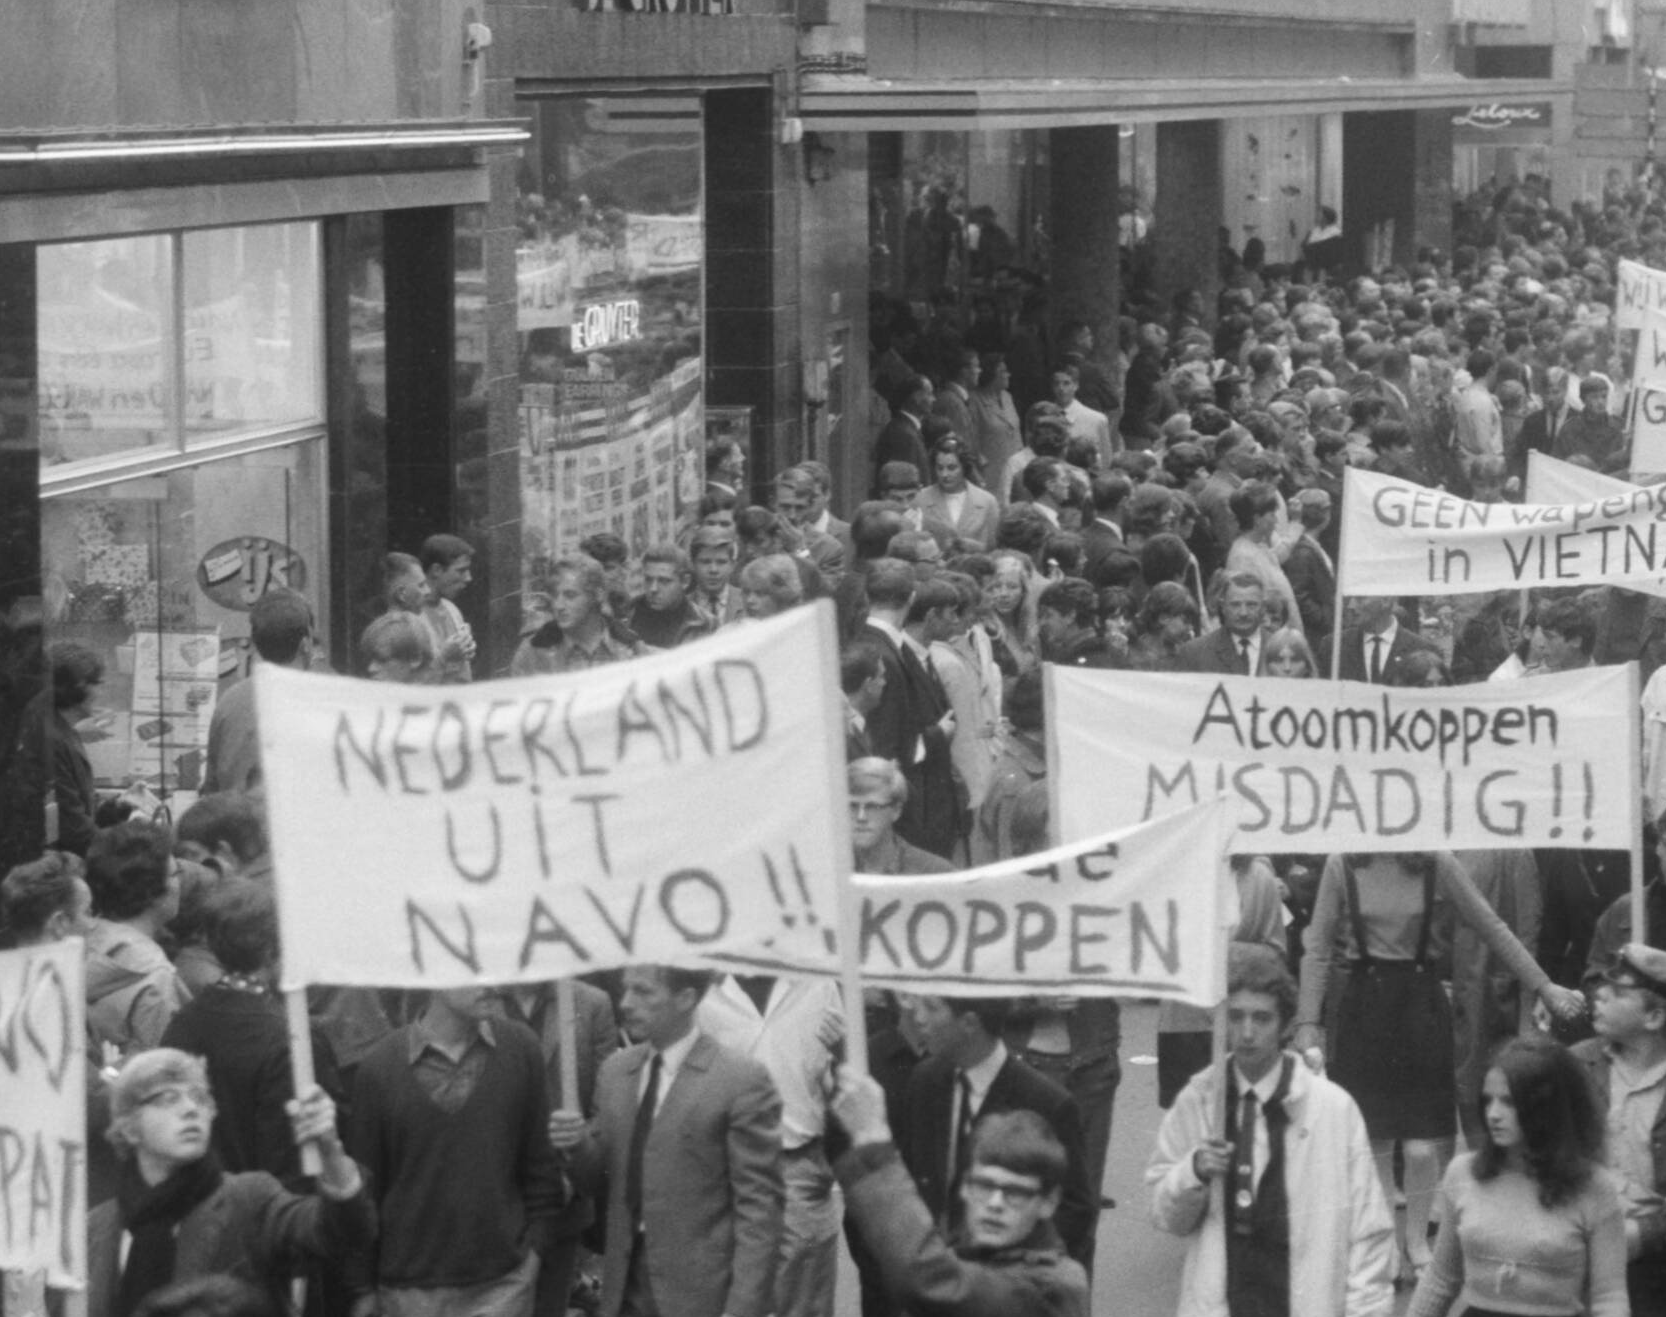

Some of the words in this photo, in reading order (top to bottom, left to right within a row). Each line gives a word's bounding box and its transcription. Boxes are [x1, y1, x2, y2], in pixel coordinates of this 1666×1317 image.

[1371, 484, 1492, 530] GEEN
[1426, 538, 1472, 585] in
[333, 658, 771, 797] NEDERLAND
[1191, 681, 1559, 766] Atoomkoppen
